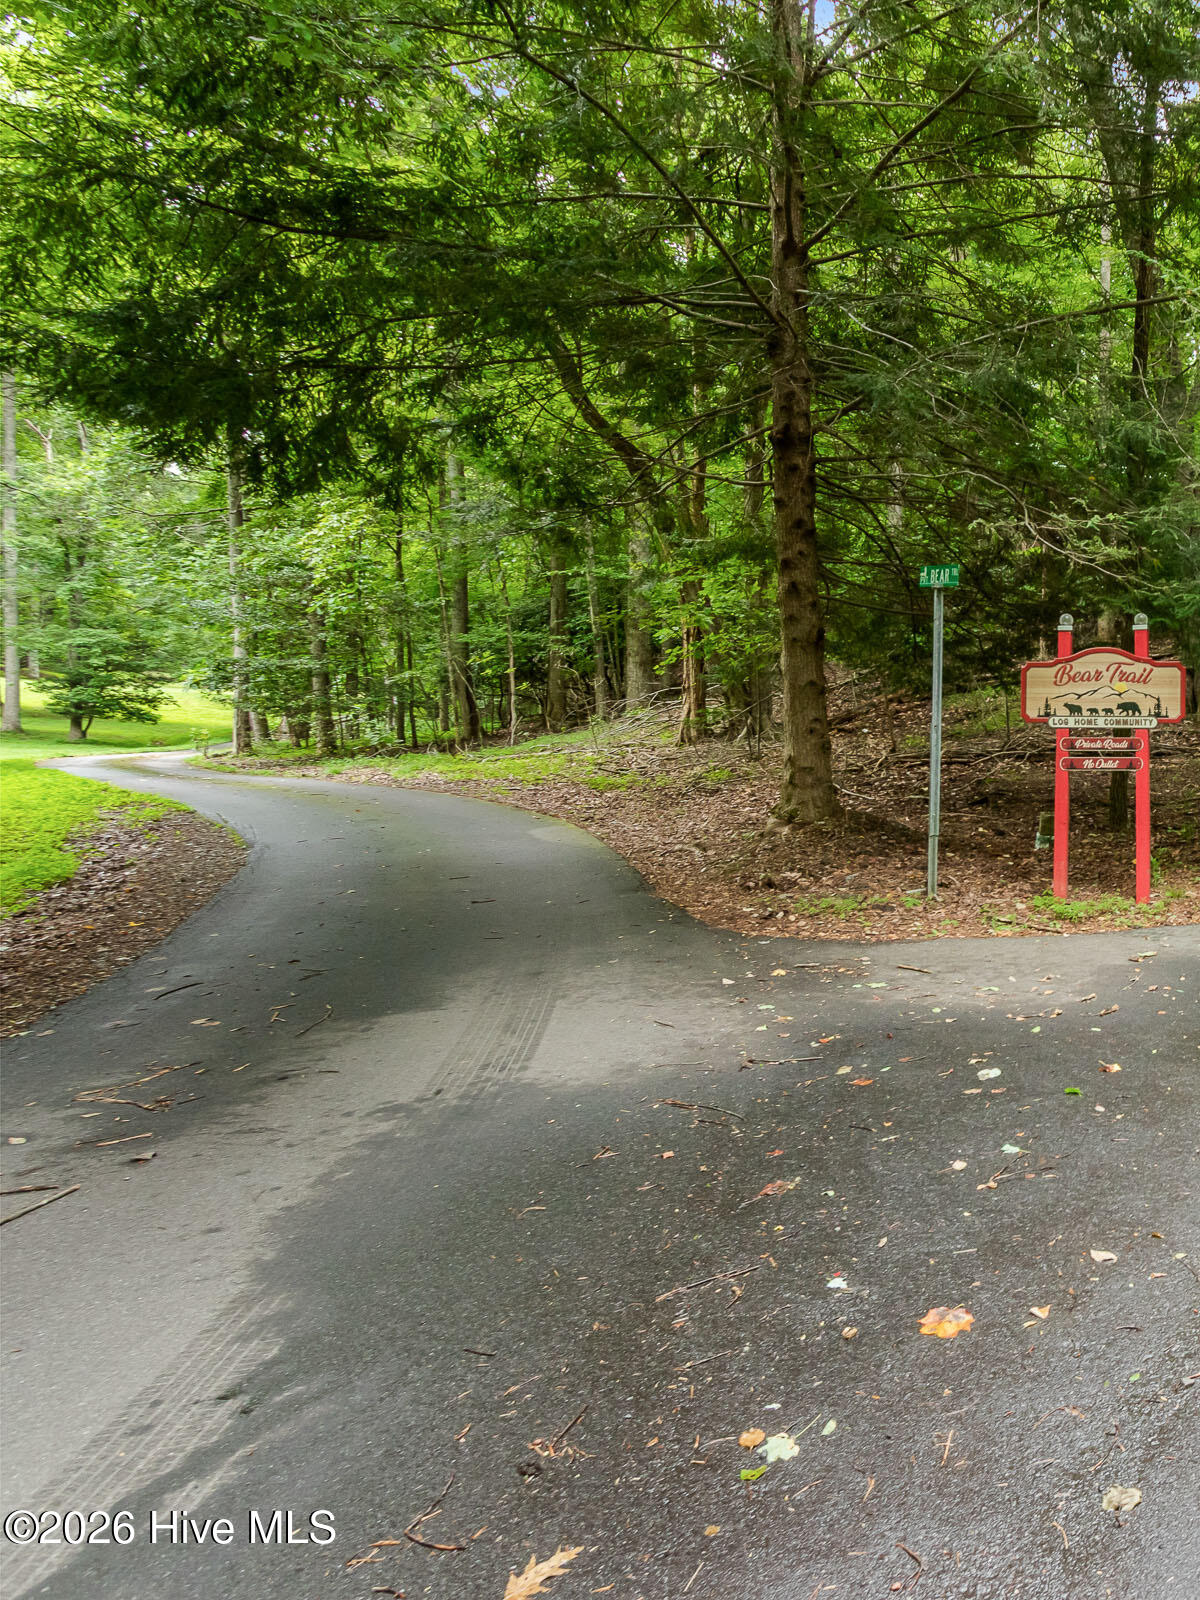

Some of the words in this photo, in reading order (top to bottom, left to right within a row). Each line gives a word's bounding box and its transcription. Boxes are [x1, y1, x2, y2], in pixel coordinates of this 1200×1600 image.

[930, 569, 950, 584] BEAR
[1053, 663, 1104, 687] Bear
[1105, 662, 1154, 685] Trail
[1052, 718, 1069, 726] LOG
[1074, 718, 1099, 726] HOME
[1103, 718, 1154, 726] COMMUNITY
[1074, 739, 1102, 749] Private
[1103, 739, 1129, 750] Roads
[1082, 759, 1095, 769] No
[1095, 759, 1119, 769] Outlet
